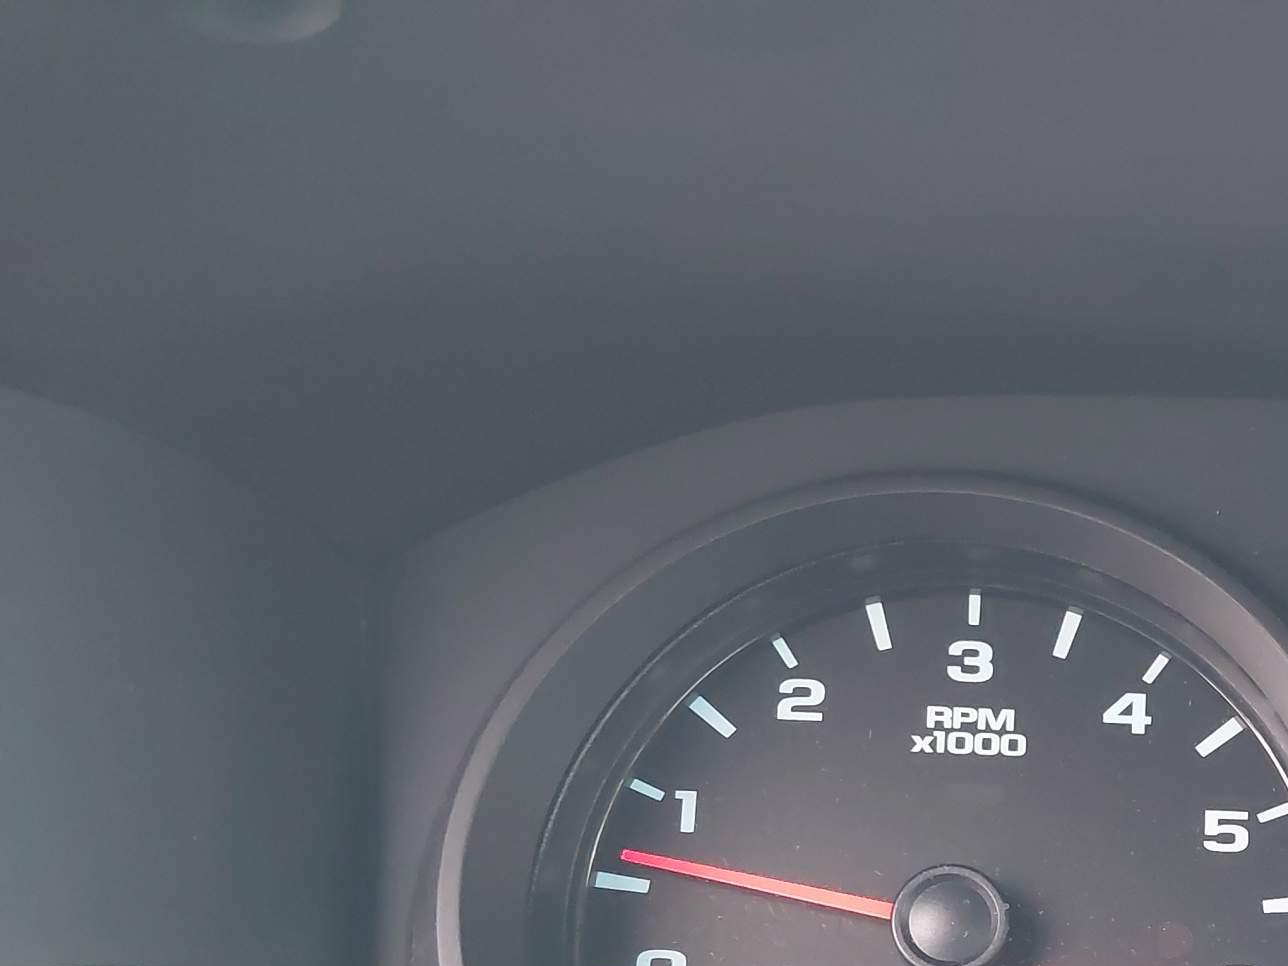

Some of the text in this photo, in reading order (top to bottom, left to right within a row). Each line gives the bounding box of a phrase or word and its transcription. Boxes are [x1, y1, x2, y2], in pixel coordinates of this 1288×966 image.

[946, 640, 994, 683] 3
[777, 678, 826, 722] 2
[926, 706, 1015, 732] RPM
[1102, 692, 1152, 735] 4
[910, 732, 1027, 757] x1000
[674, 790, 698, 833] 1
[1203, 809, 1249, 853] 5
